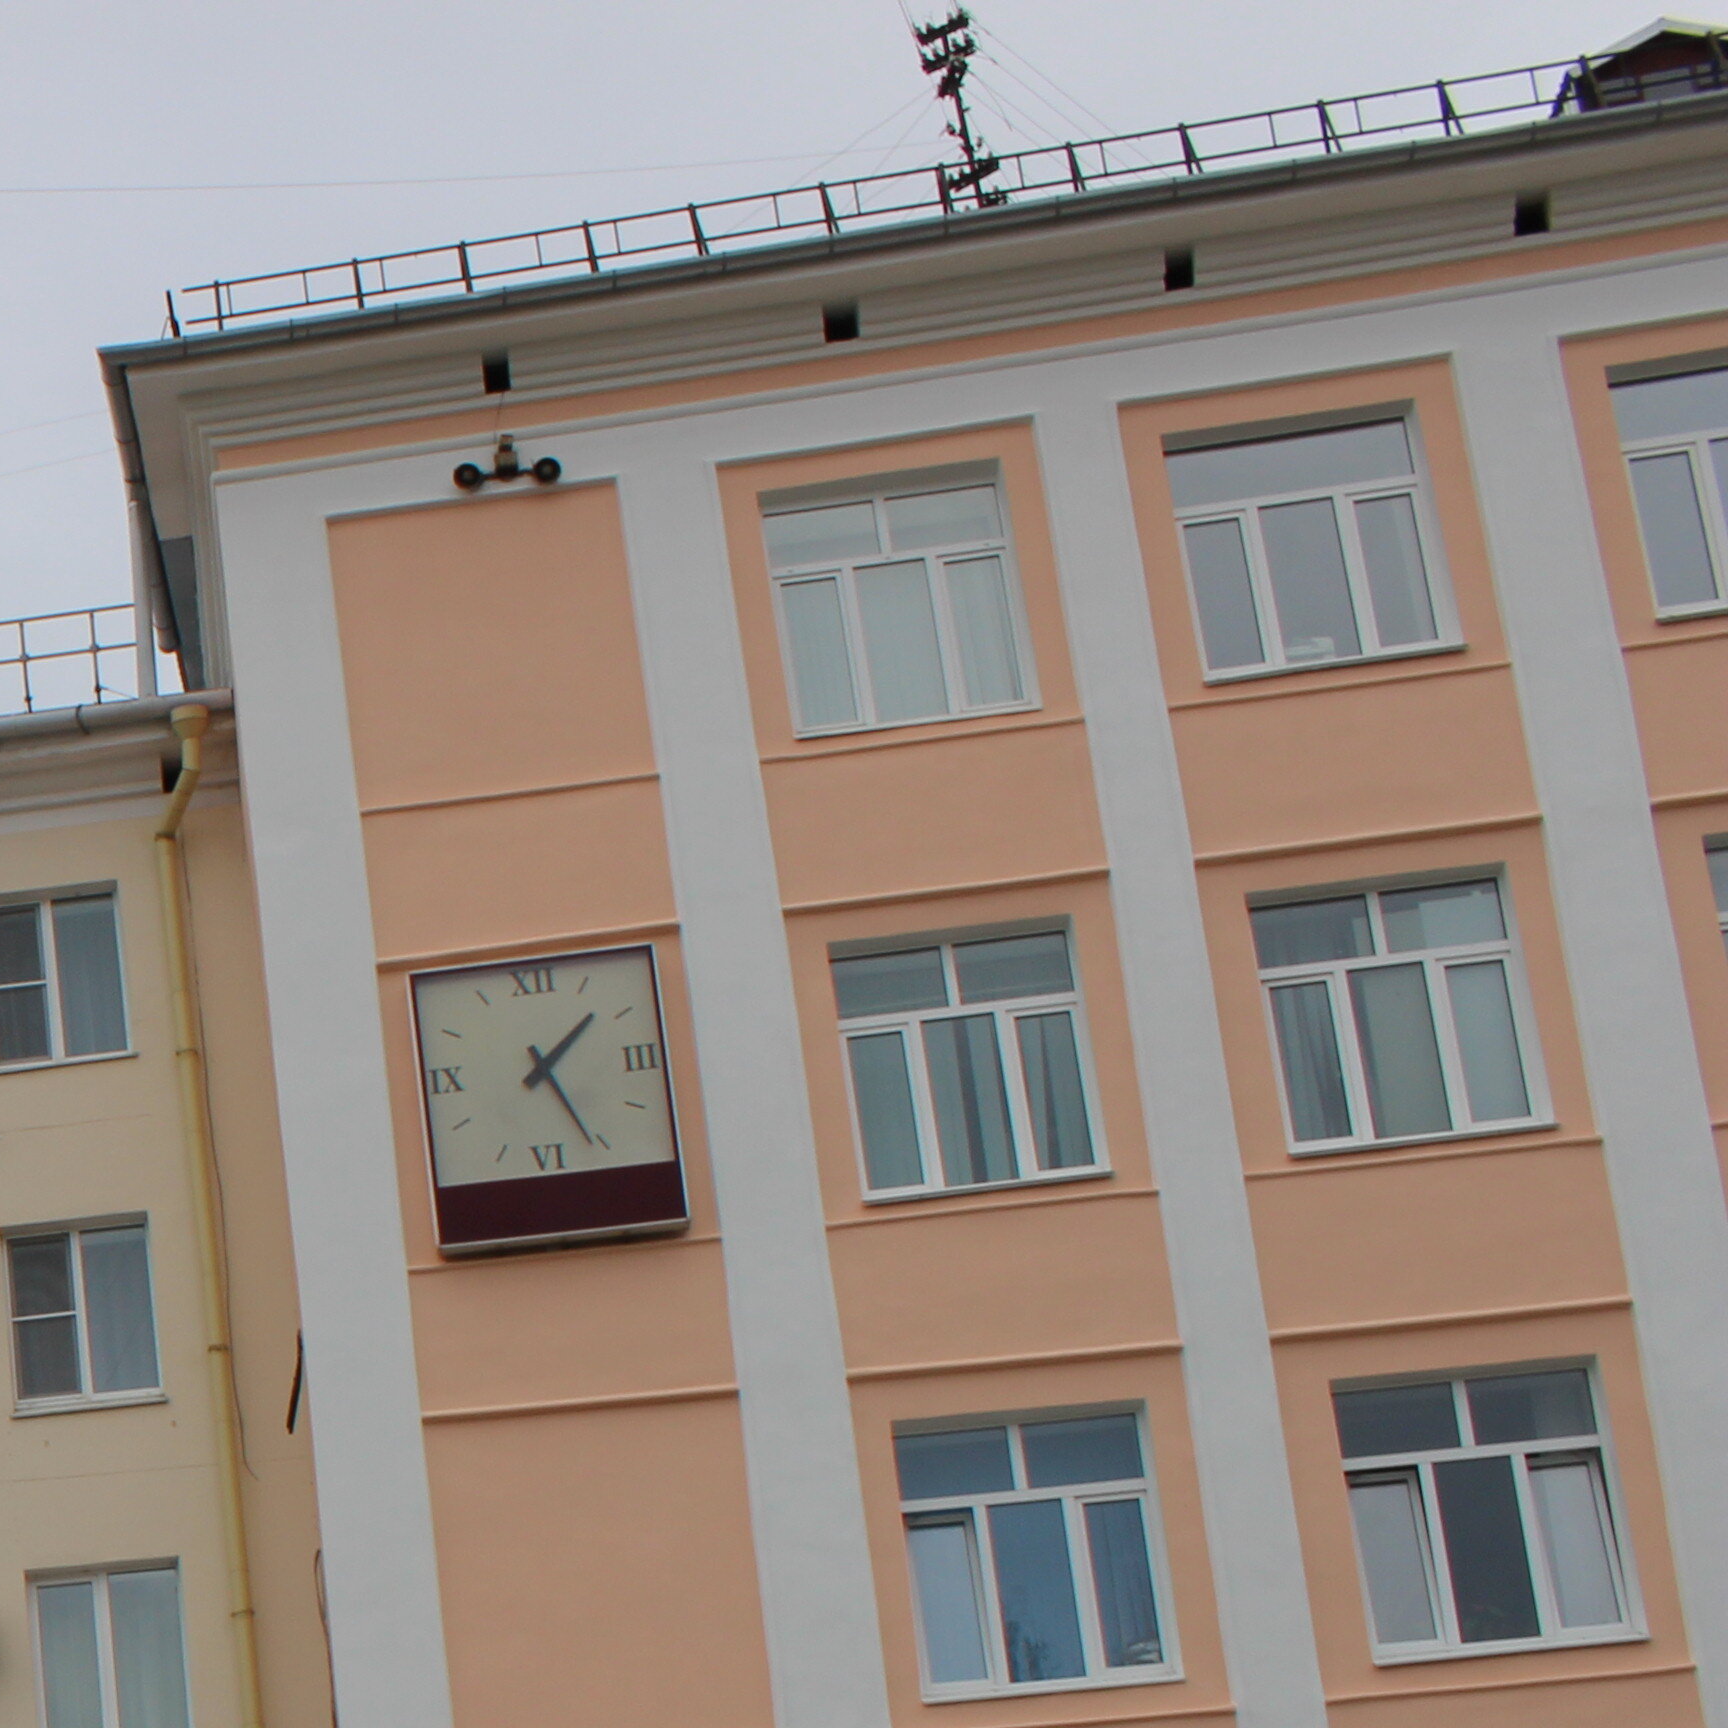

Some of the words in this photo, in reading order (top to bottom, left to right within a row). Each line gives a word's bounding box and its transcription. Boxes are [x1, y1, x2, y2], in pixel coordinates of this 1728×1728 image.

[509, 967, 556, 997] XII
[622, 1043, 660, 1072] III
[429, 1066, 465, 1095] IX
[529, 1143, 567, 1171] VI
